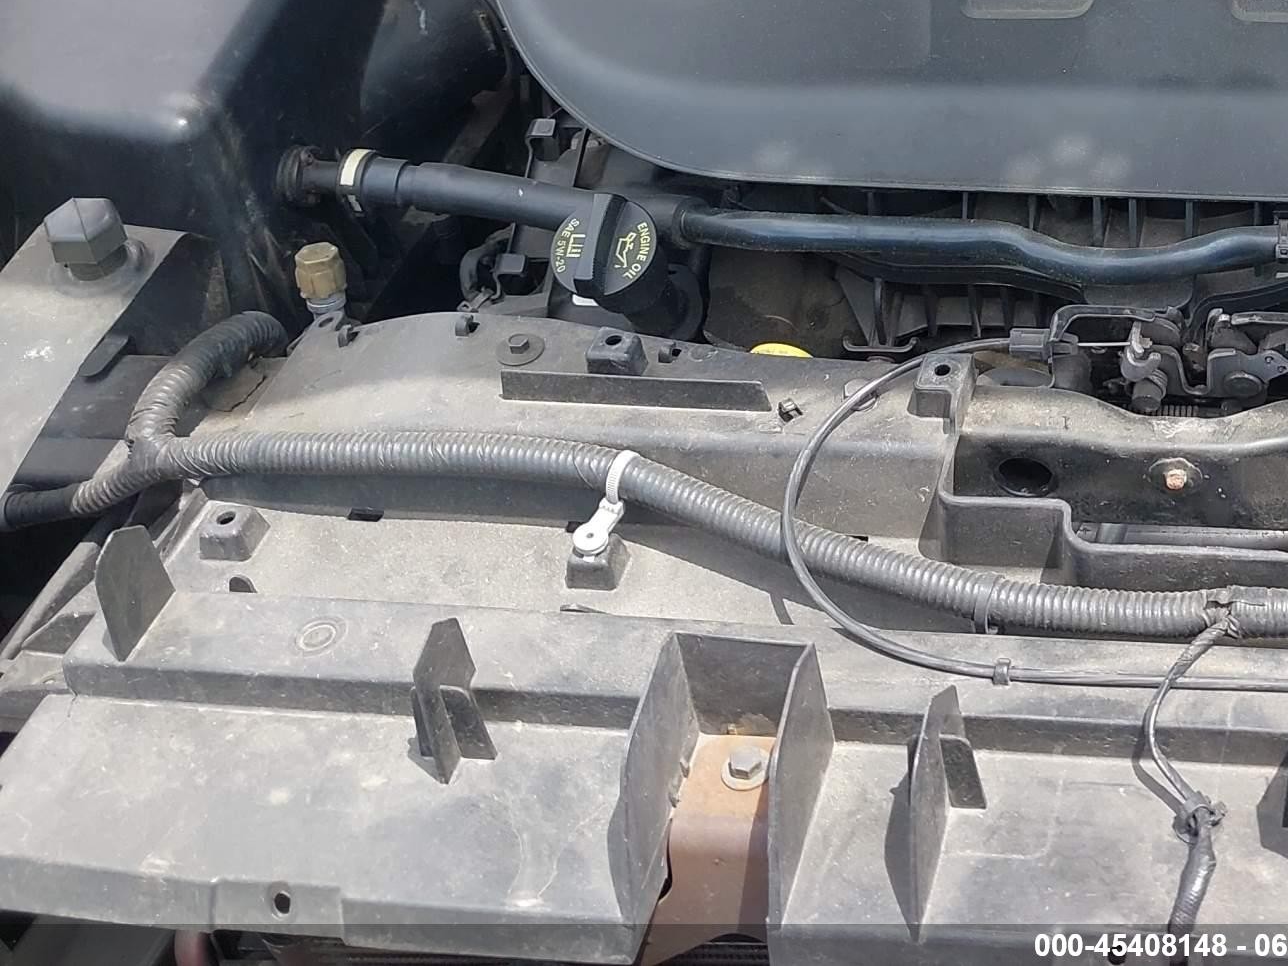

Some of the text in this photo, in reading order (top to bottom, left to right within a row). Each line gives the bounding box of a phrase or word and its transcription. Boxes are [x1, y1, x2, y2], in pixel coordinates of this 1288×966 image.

[554, 218, 580, 273] SAE 5W-20
[623, 221, 650, 279] ENGINE OIL
